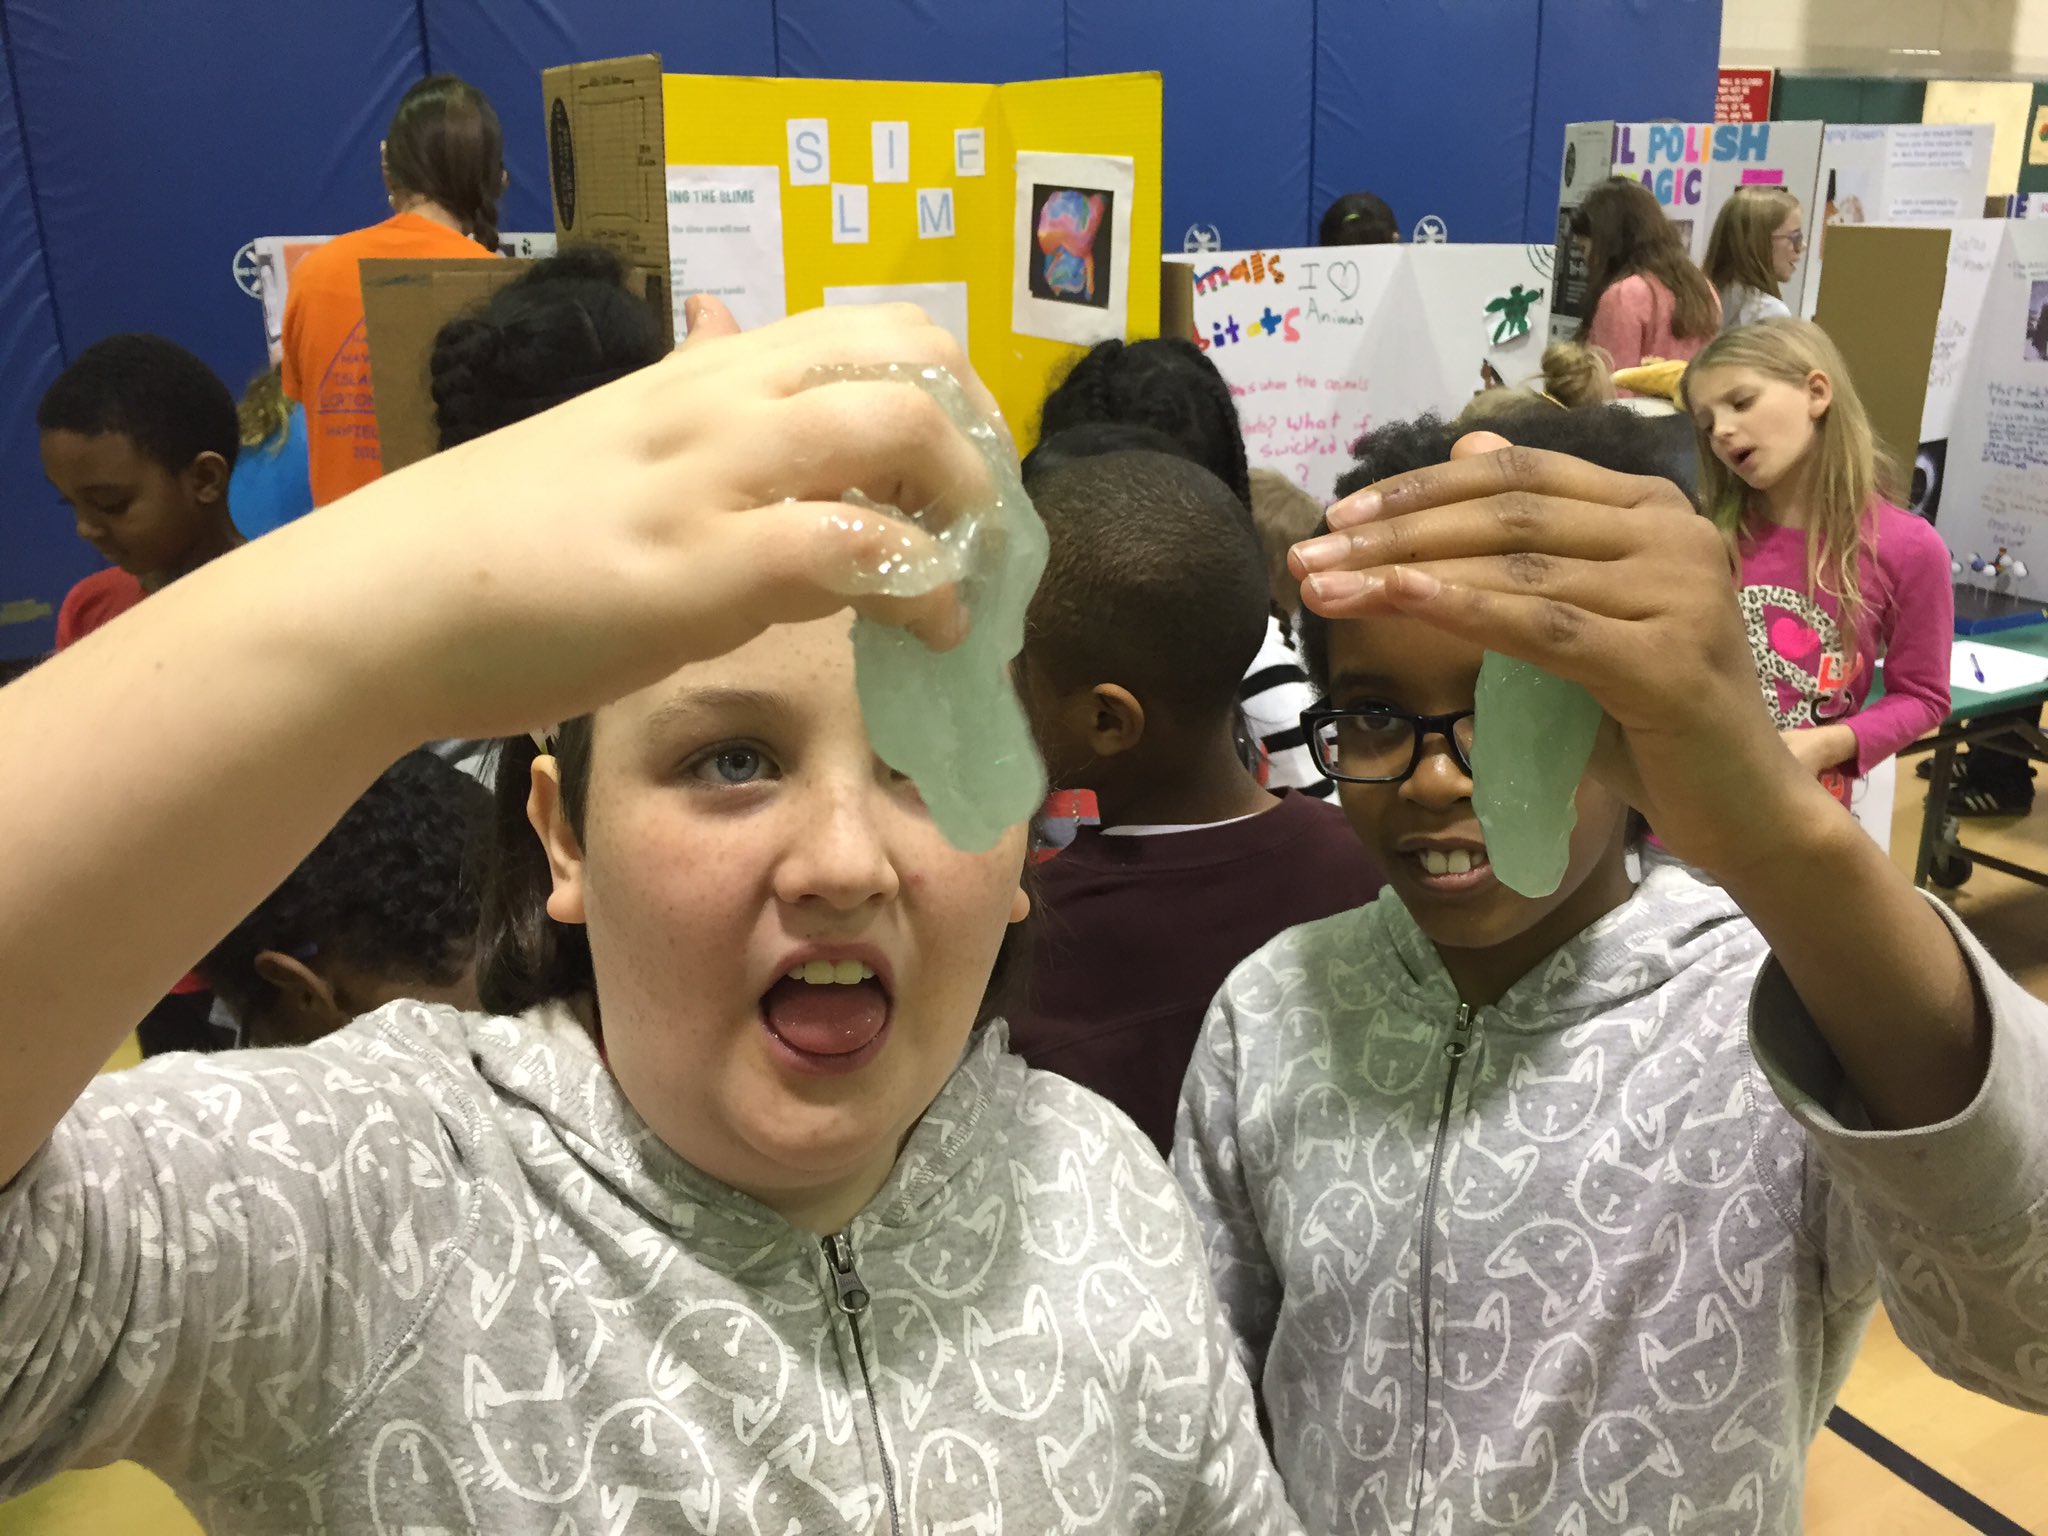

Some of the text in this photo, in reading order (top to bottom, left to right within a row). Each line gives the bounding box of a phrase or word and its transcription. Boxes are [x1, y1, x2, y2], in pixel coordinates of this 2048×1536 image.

[1648, 123, 1770, 164] POLISH
[693, 190, 716, 203] THE
[1305, 297, 1364, 326] Animals
